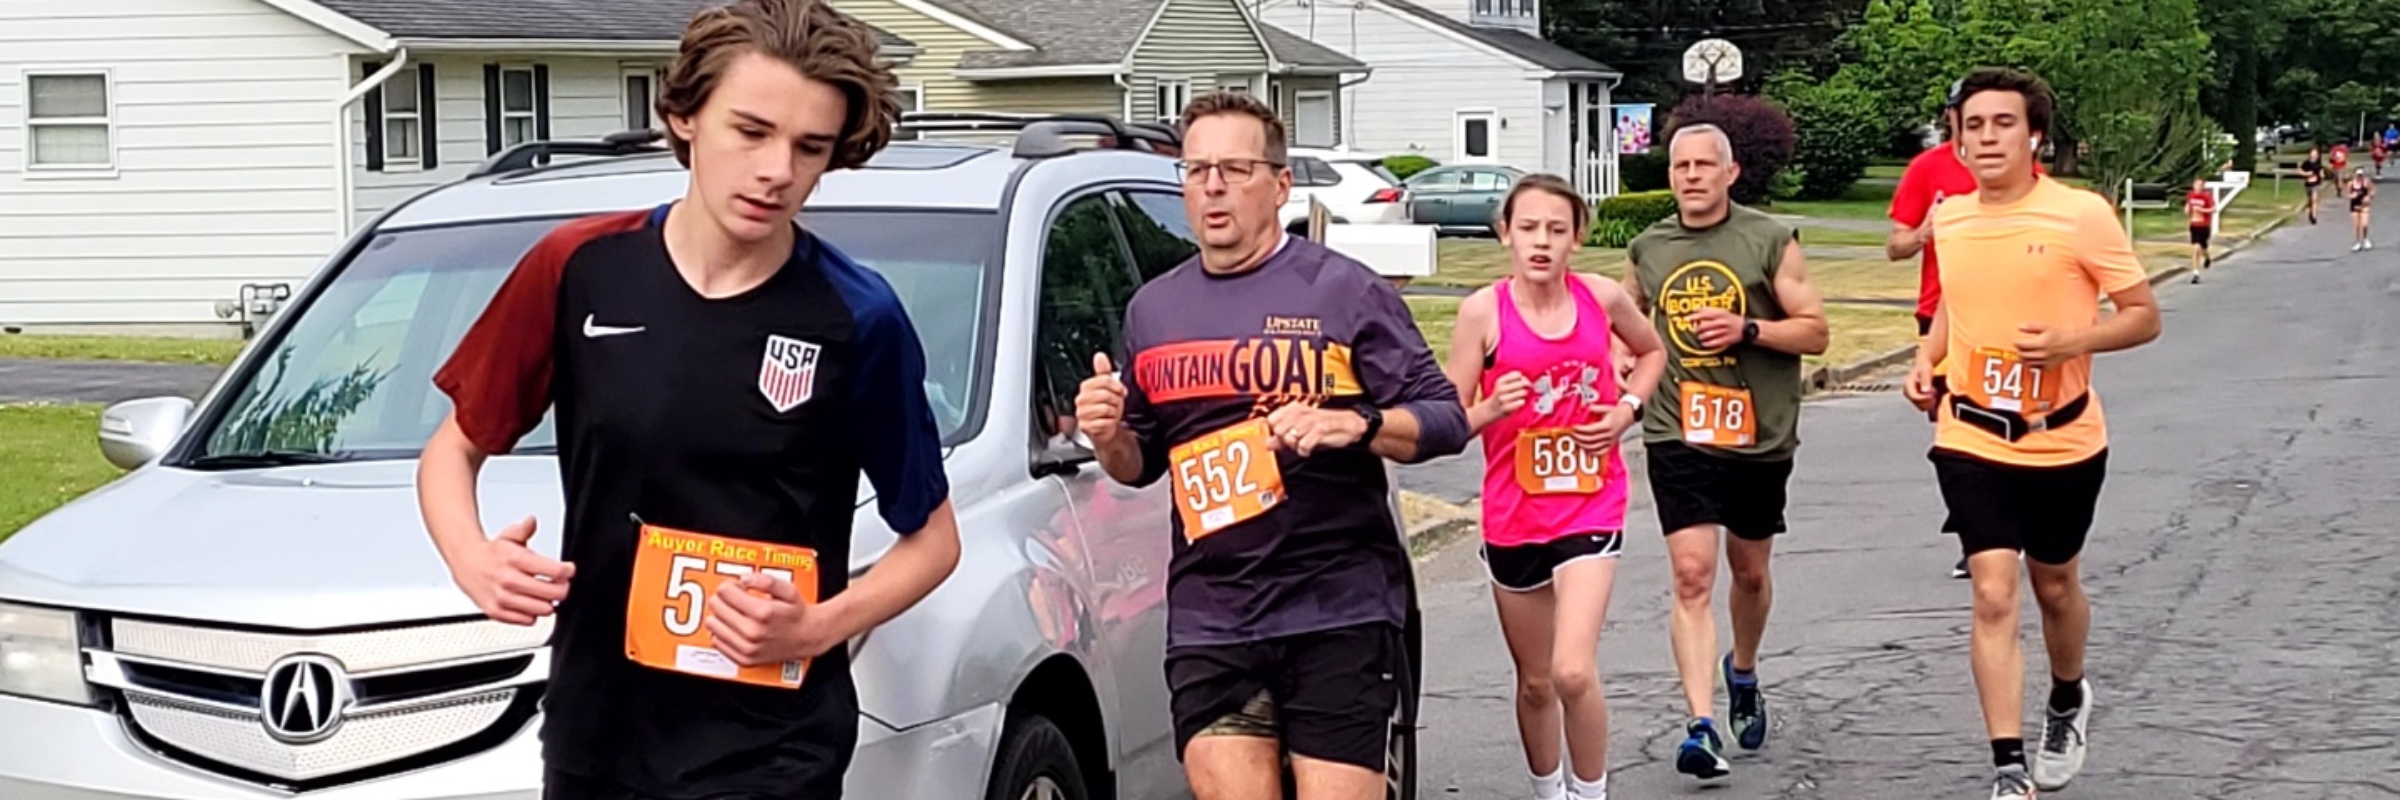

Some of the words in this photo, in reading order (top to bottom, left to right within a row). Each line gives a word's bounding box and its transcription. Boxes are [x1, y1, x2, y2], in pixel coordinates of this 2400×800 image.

[769, 339, 818, 370] USA
[1228, 337, 1327, 394] GOAT
[1983, 356, 2043, 400] 541
[1689, 393, 1744, 431] 518
[1178, 440, 1258, 512] 552
[710, 539, 758, 562] Race
[763, 546, 815, 573] Timing
